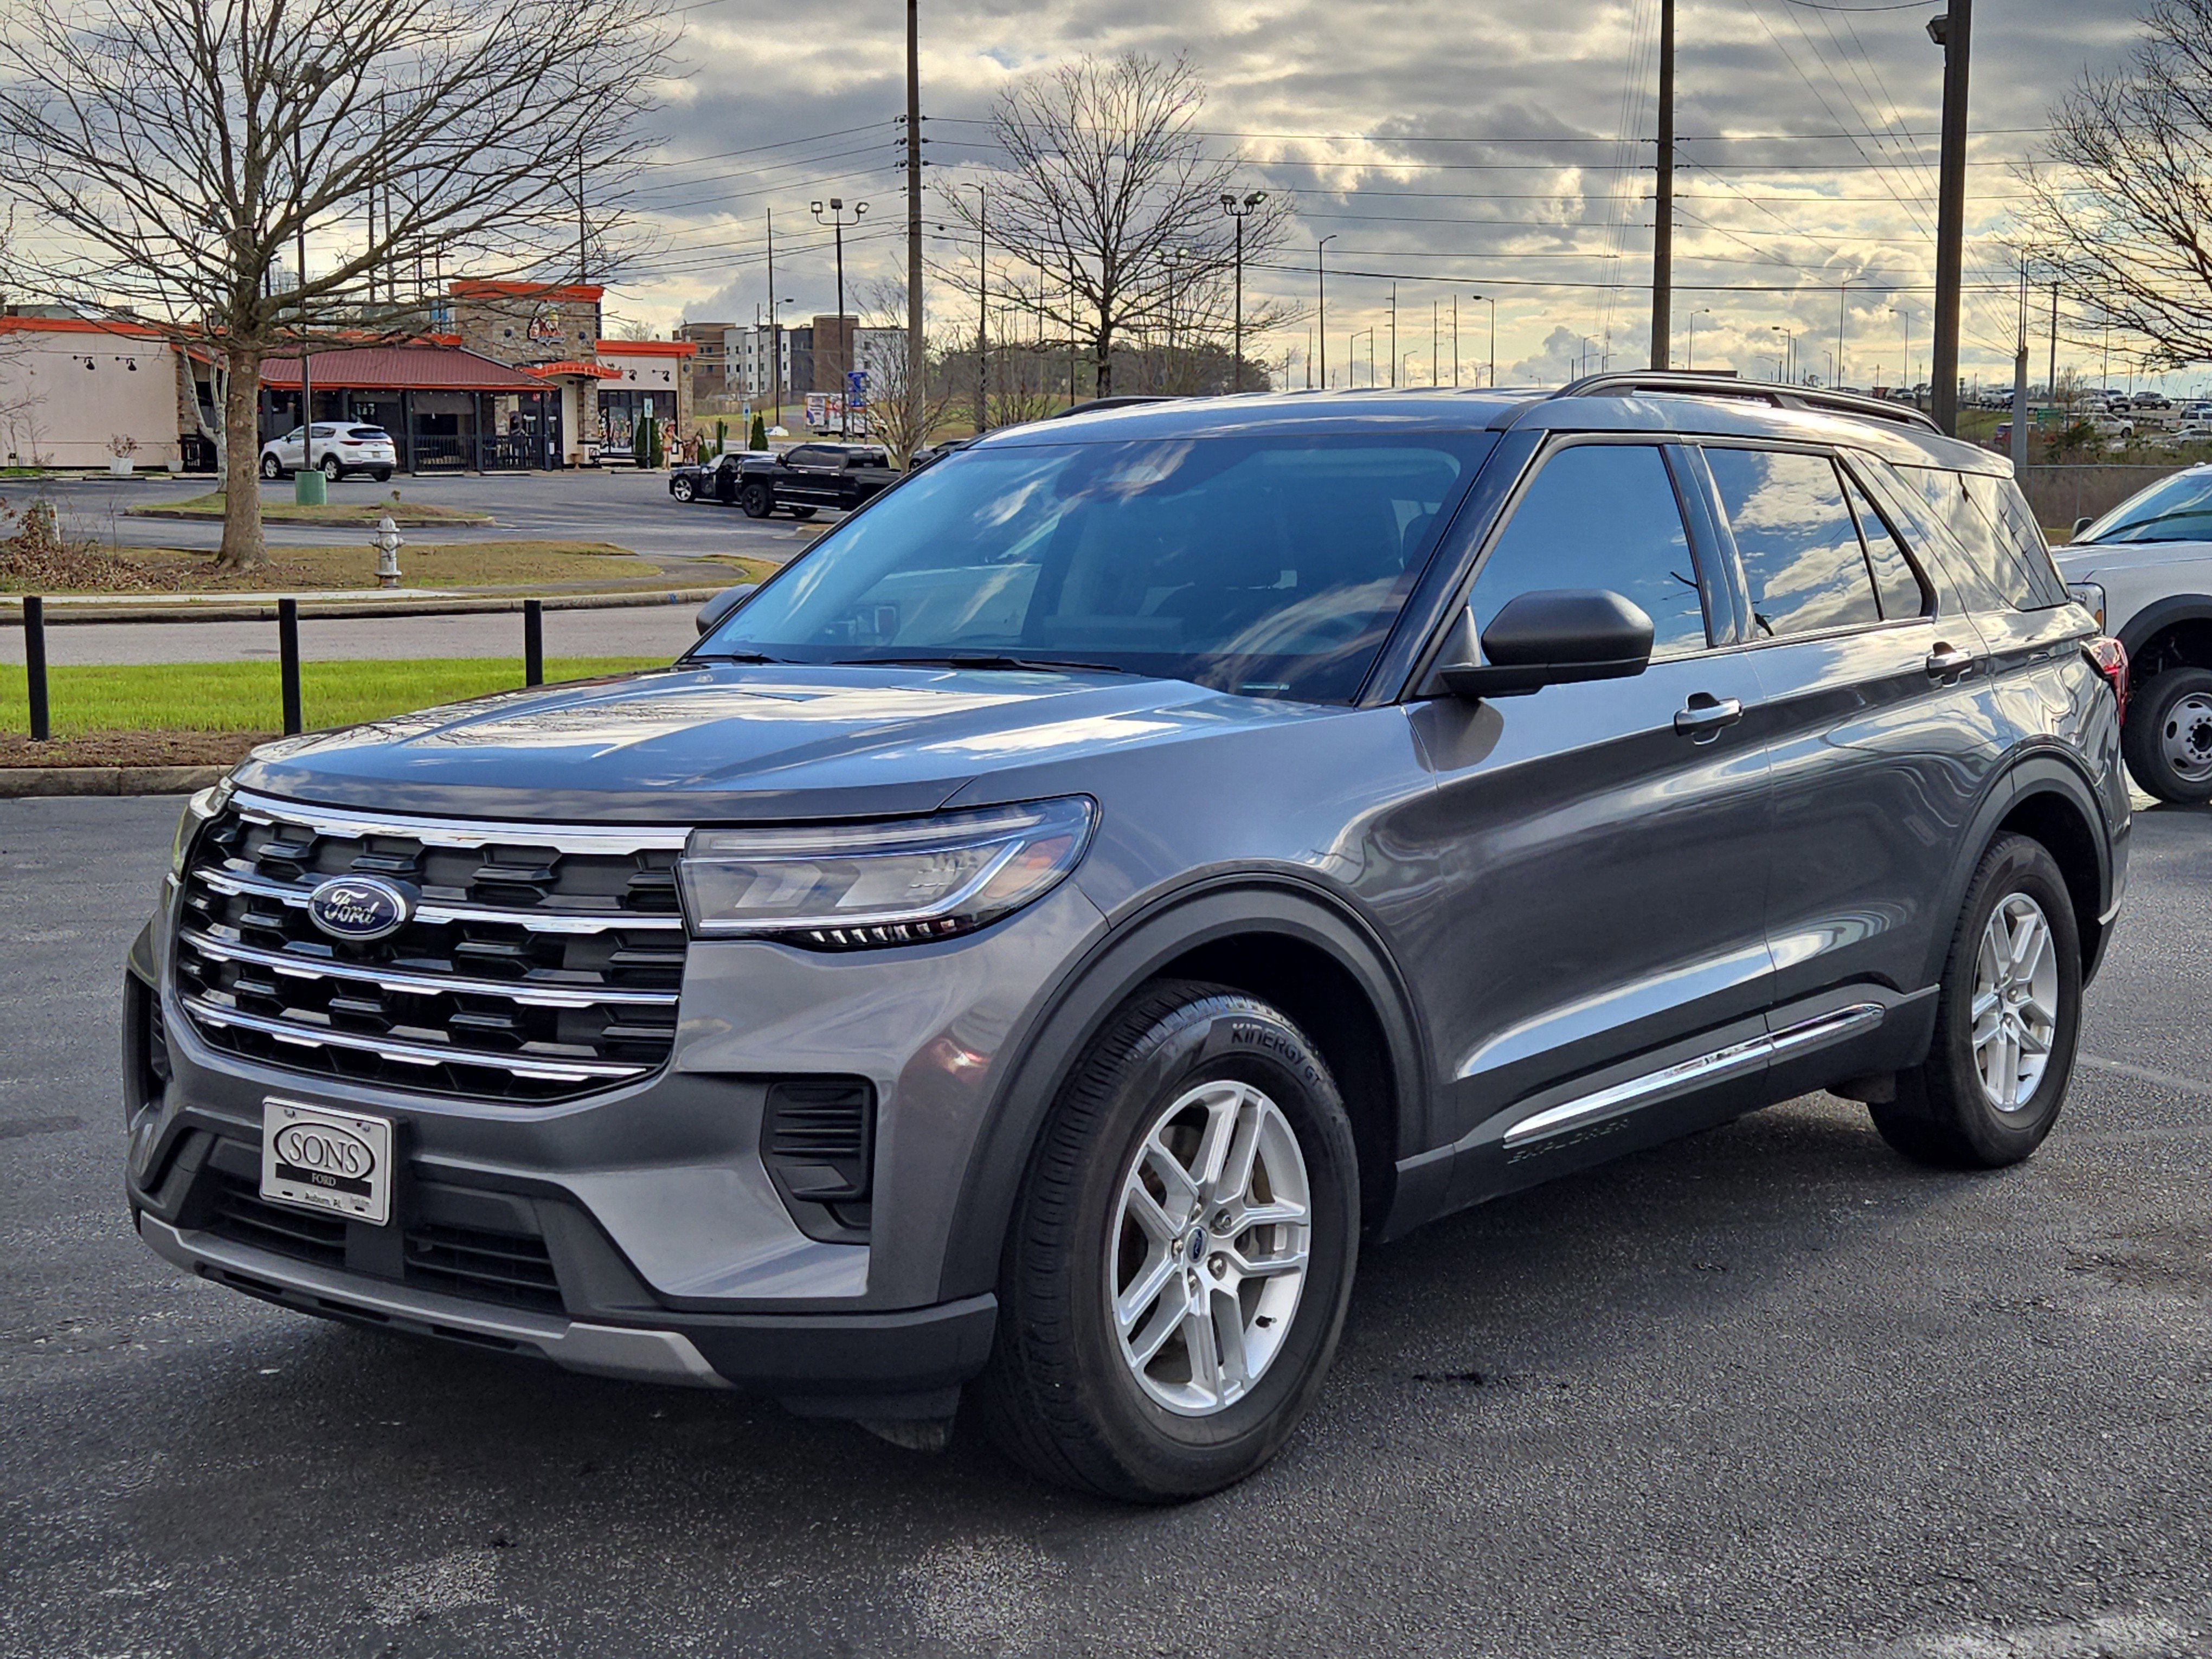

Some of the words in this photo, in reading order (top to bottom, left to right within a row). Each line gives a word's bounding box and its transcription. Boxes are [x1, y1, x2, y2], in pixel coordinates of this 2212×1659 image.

[324, 889, 380, 925] Ford
[1231, 1023, 1307, 1064] KINERGY
[1304, 1065, 1322, 1085] GT
[289, 1131, 359, 1173] SONS
[312, 1173, 336, 1186] FORD
